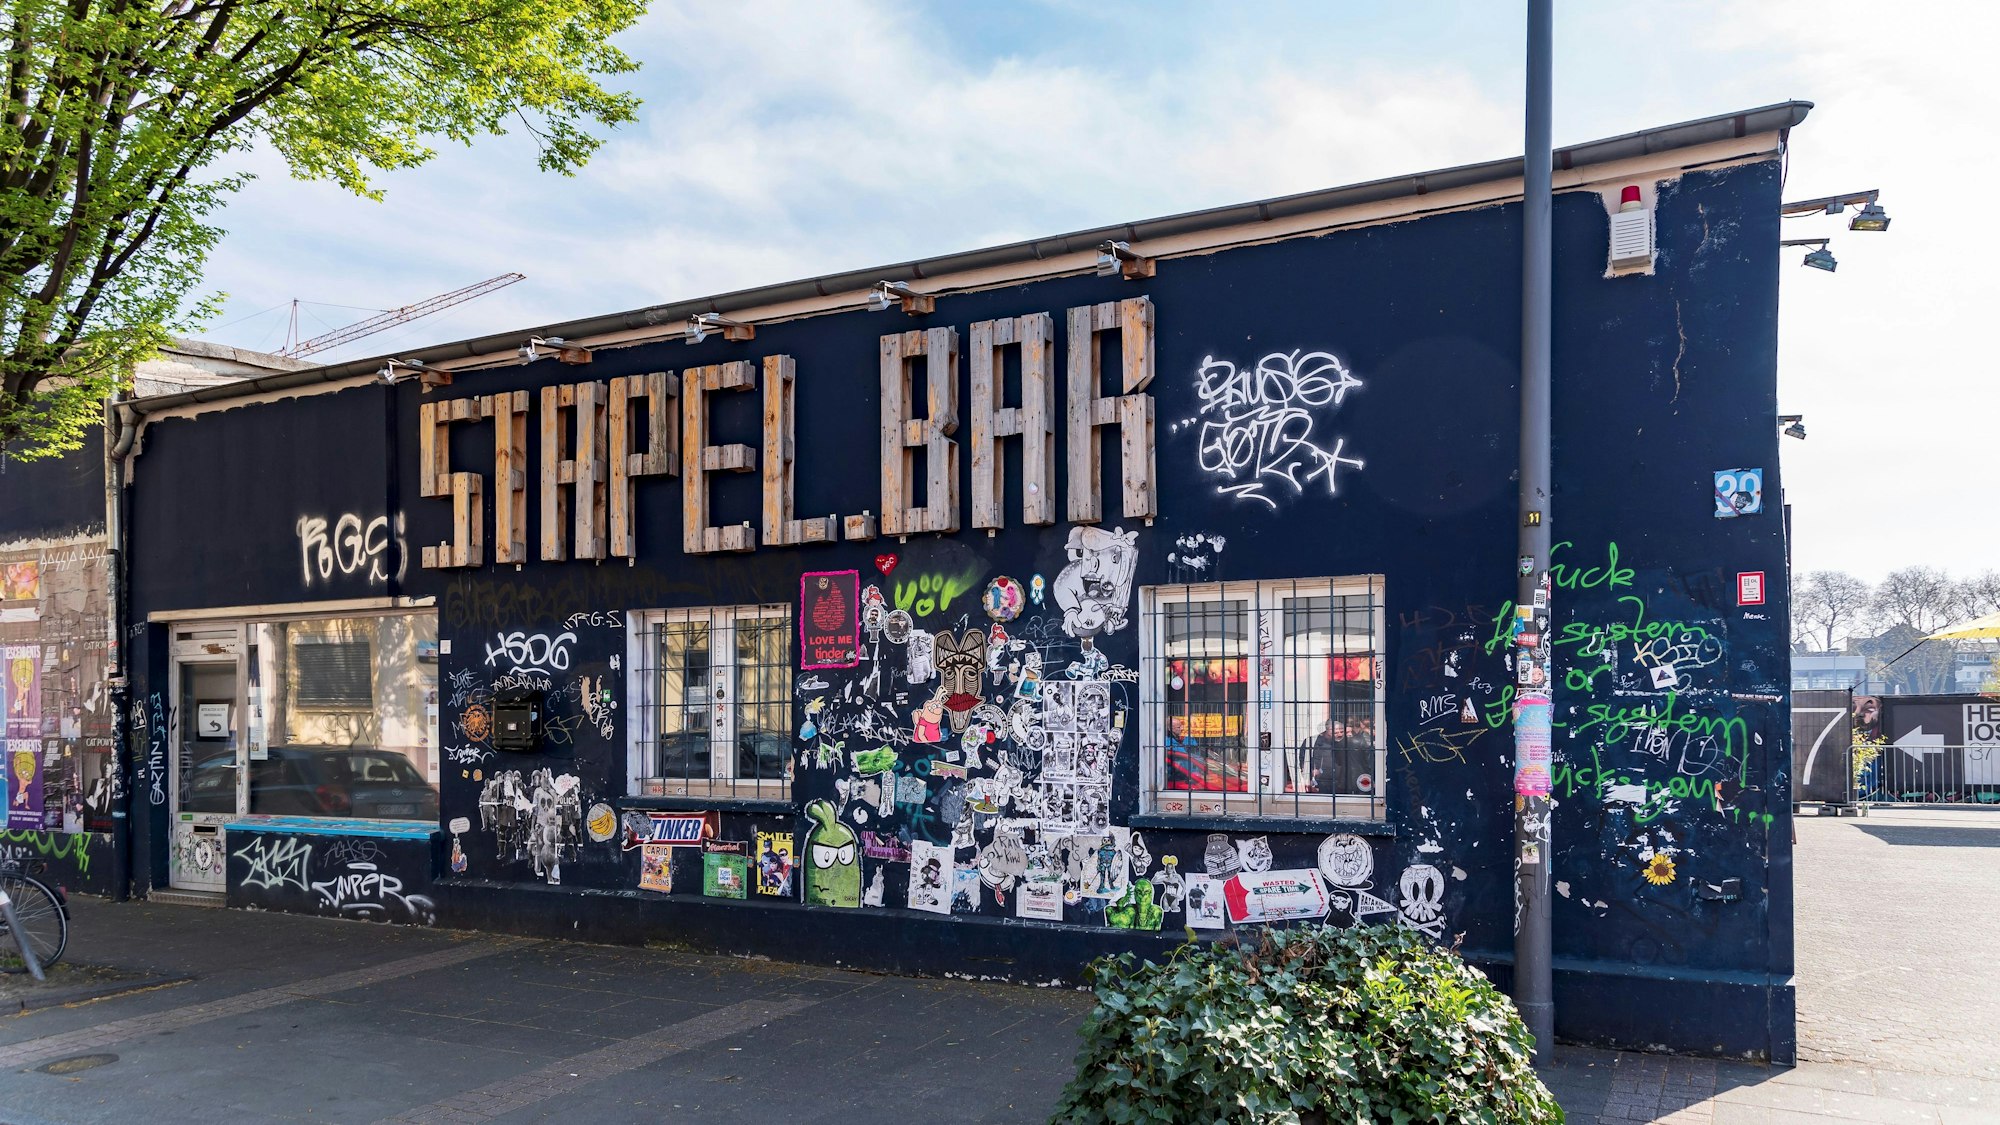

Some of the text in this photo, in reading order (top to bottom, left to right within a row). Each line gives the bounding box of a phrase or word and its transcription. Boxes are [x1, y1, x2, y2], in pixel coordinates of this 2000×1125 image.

[809, 636, 853, 645] LOVE ME
[815, 647, 846, 660] tinder
[1565, 664, 1612, 692] or
[1967, 723, 2000, 741] IO
[557, 796, 576, 806] POLICE
[648, 819, 701, 841] TINKER
[757, 831, 794, 842] SMILE
[1260, 886, 1281, 894] SPARE
